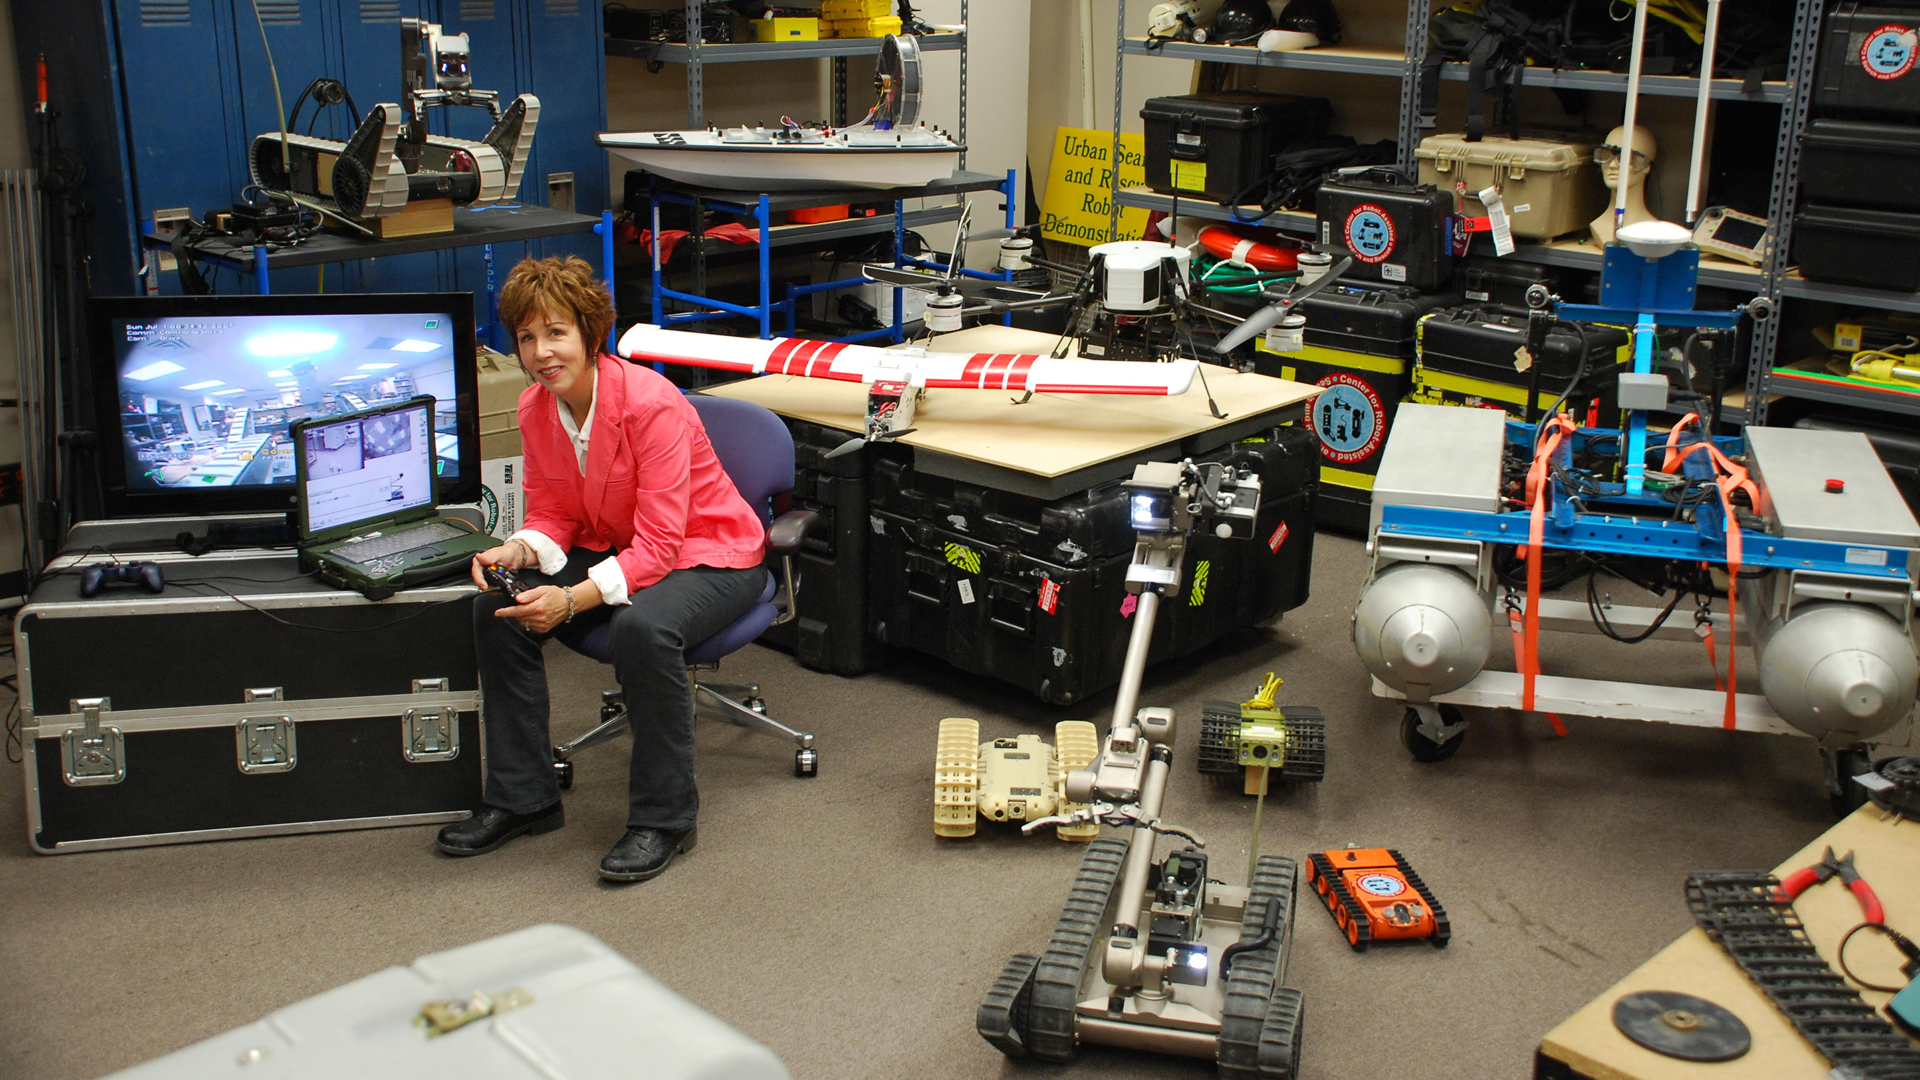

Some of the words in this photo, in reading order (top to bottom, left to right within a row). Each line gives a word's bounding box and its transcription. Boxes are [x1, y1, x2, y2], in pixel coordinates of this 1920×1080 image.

[1064, 136, 1107, 161] Urban
[1065, 167, 1094, 185] and
[1354, 207, 1362, 215] for
[1339, 375, 1370, 393] Center
[1368, 394, 1380, 408] for
[1337, 410, 1384, 461] Robot-Assisted
[504, 464, 513, 484] TEES
